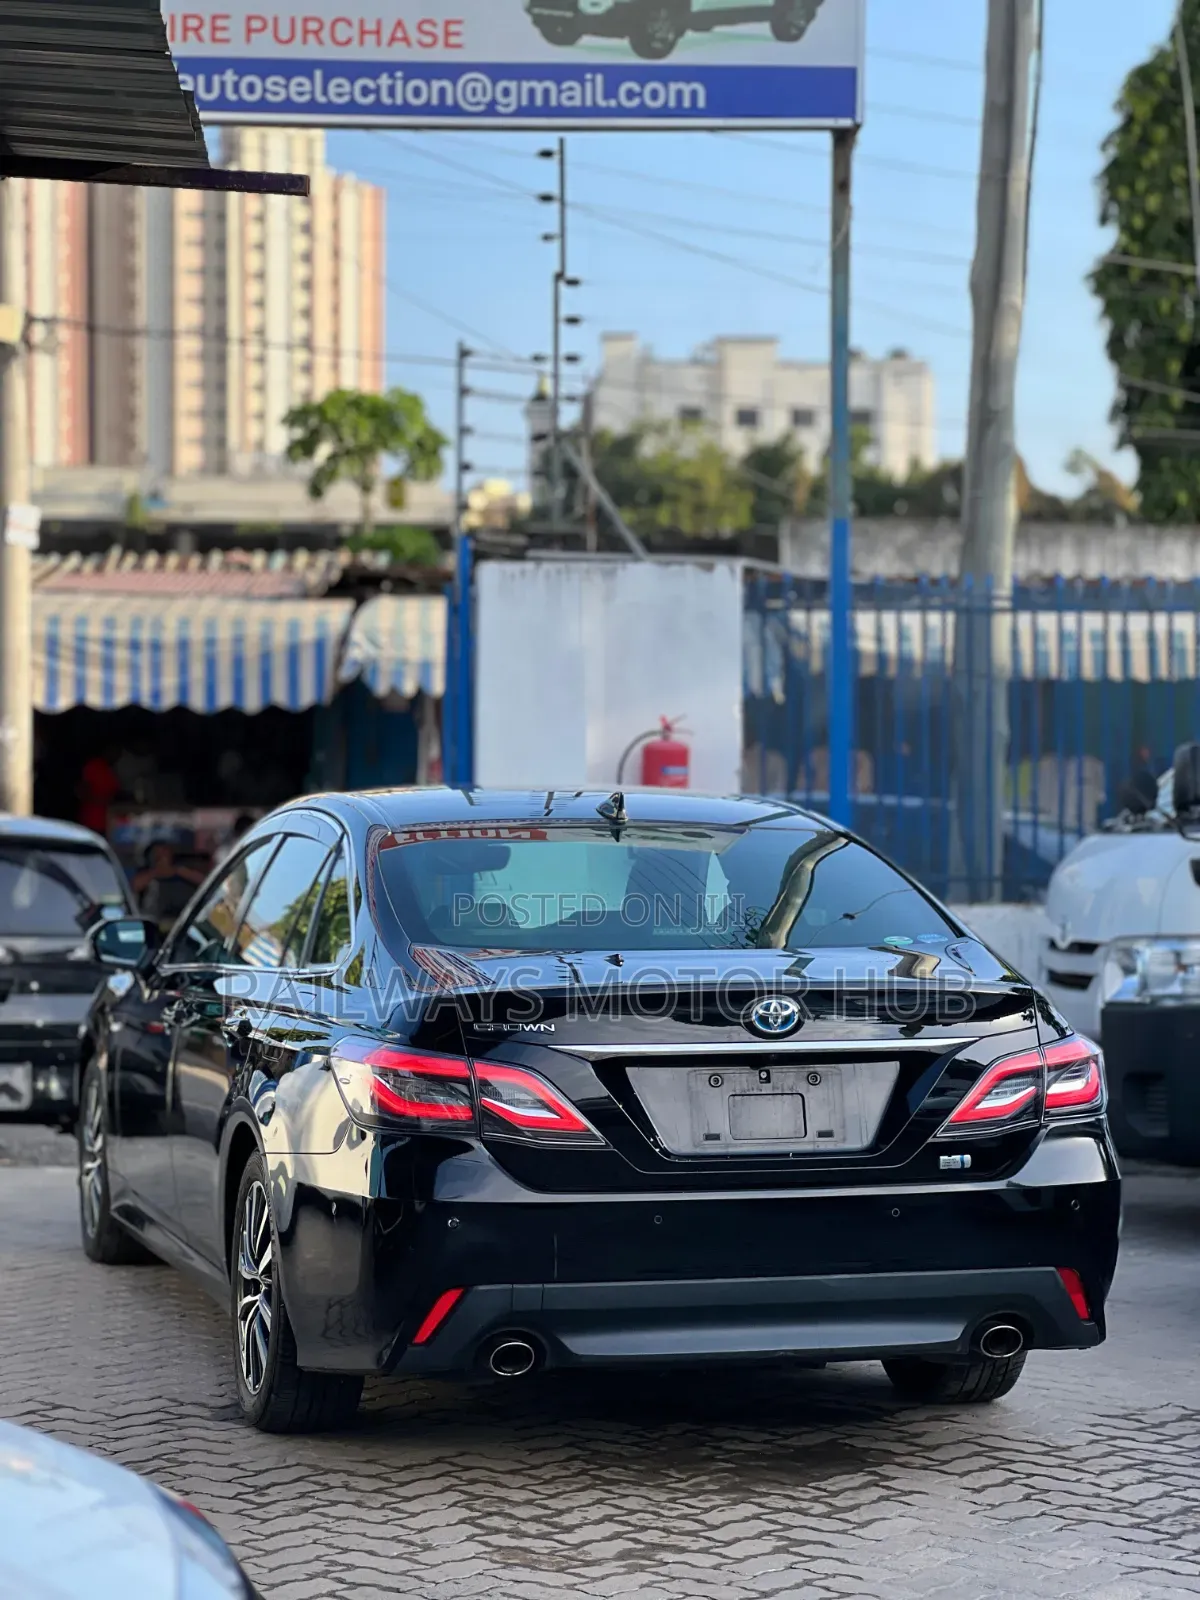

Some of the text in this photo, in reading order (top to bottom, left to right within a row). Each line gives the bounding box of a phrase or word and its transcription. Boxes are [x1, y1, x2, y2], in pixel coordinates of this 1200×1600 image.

[168, 13, 465, 49] IRE PURCHASE
[473, 1023, 556, 1032] CROWN
